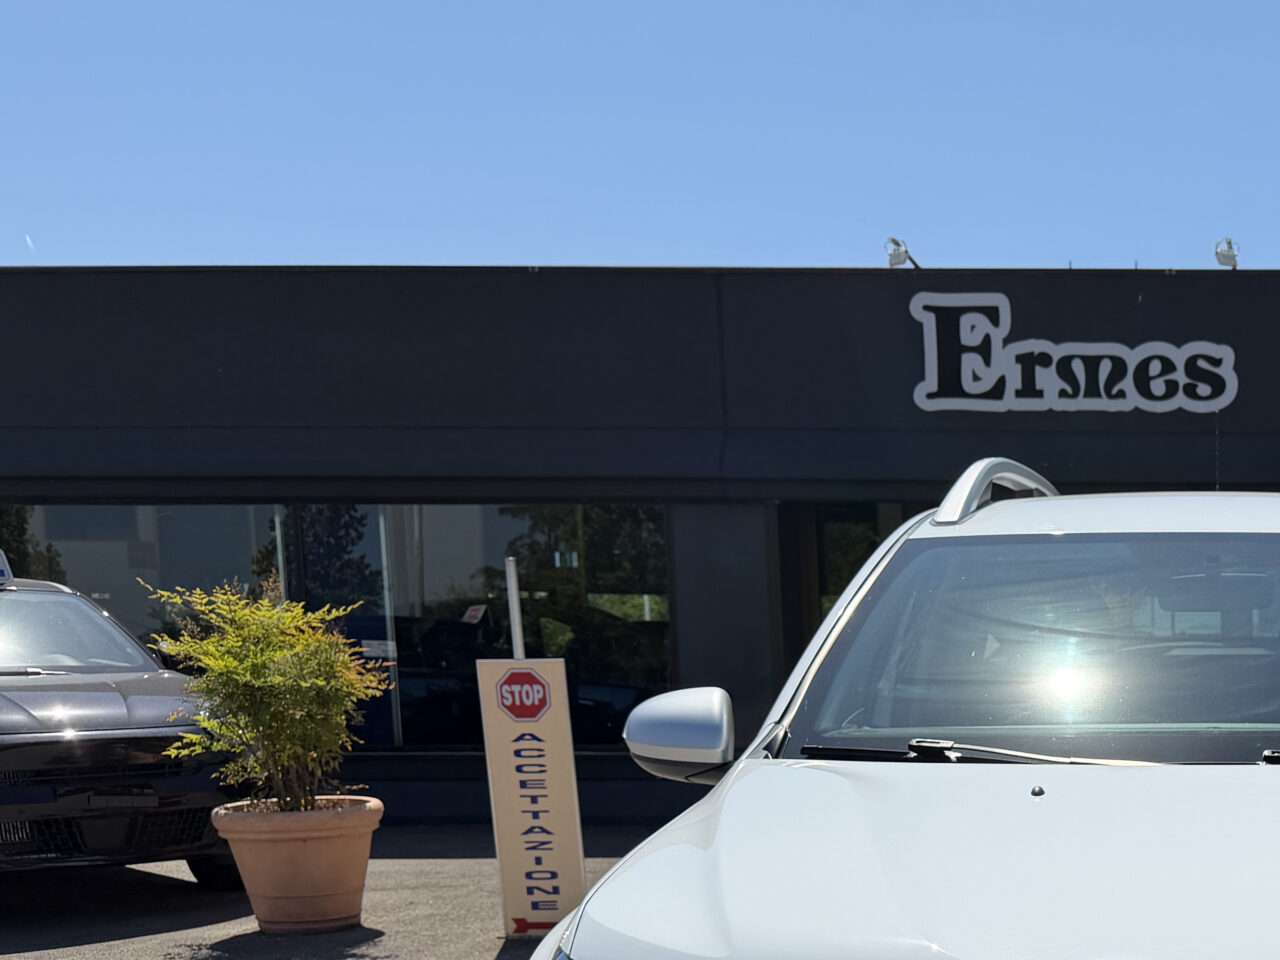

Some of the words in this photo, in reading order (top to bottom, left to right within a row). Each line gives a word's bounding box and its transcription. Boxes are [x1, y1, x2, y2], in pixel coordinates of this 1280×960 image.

[919, 303, 1229, 404] Ermes
[501, 684, 544, 706] STOP
[511, 733, 560, 911] ACCETTAZIONE
